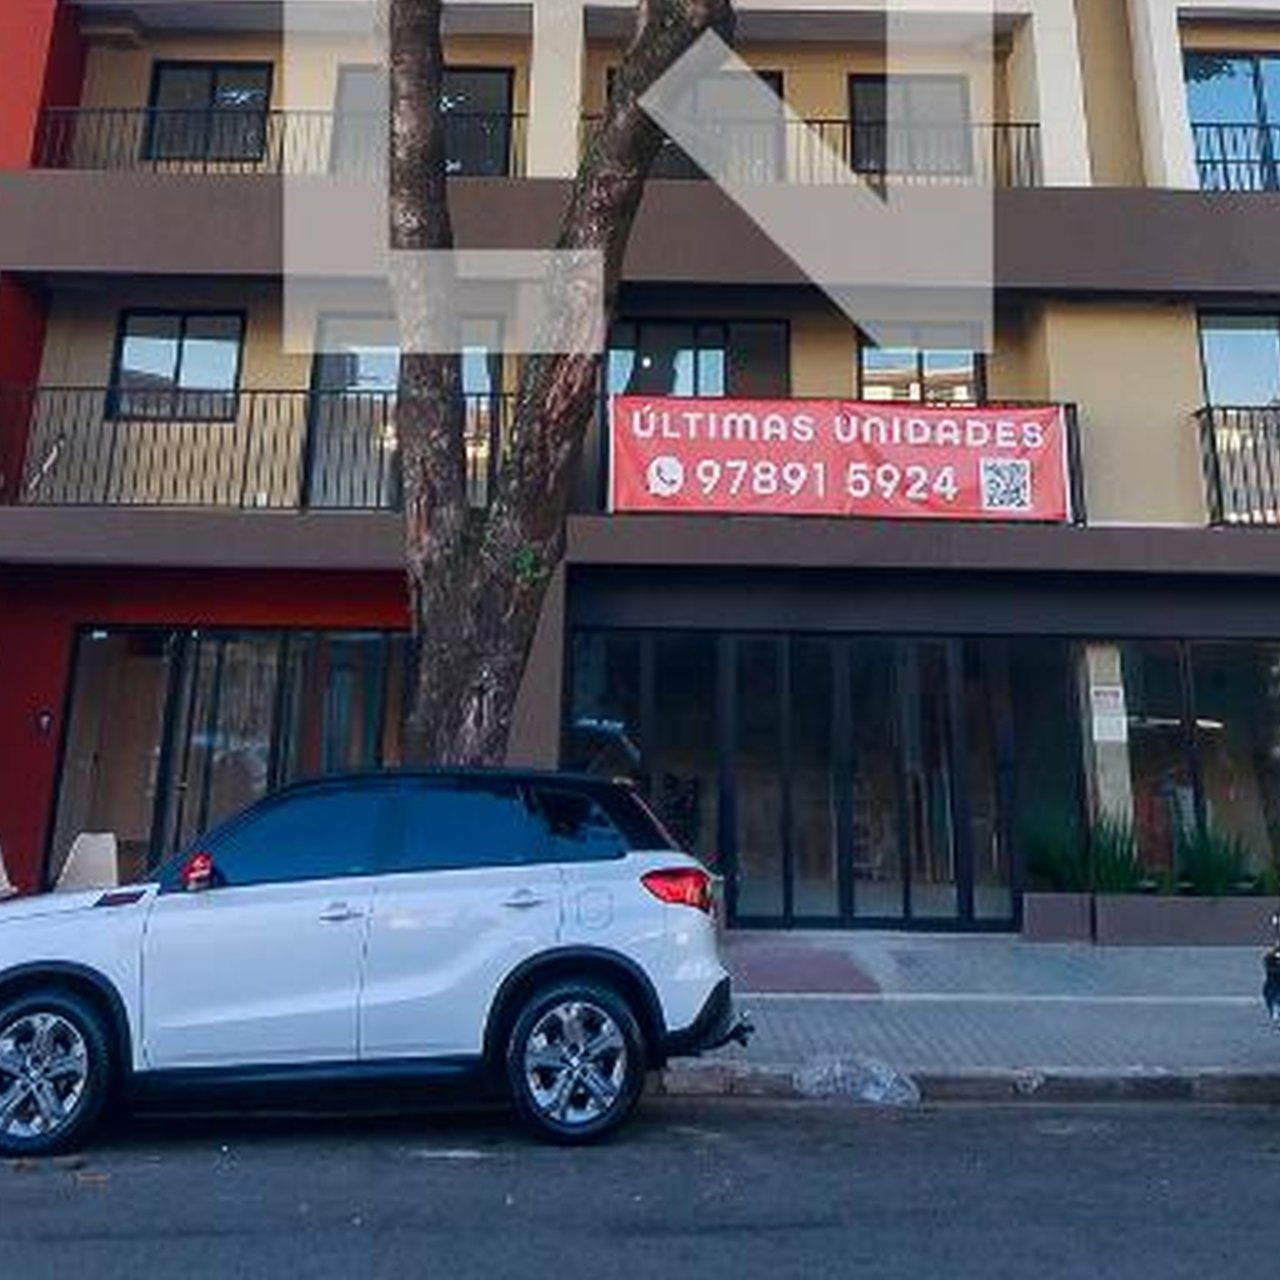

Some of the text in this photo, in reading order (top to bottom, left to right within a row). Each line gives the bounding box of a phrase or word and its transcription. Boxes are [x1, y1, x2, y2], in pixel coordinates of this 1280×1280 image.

[632, 405, 1045, 449] ÚLTIMAS UNIDADES
[696, 459, 960, 501] 97891 5924
